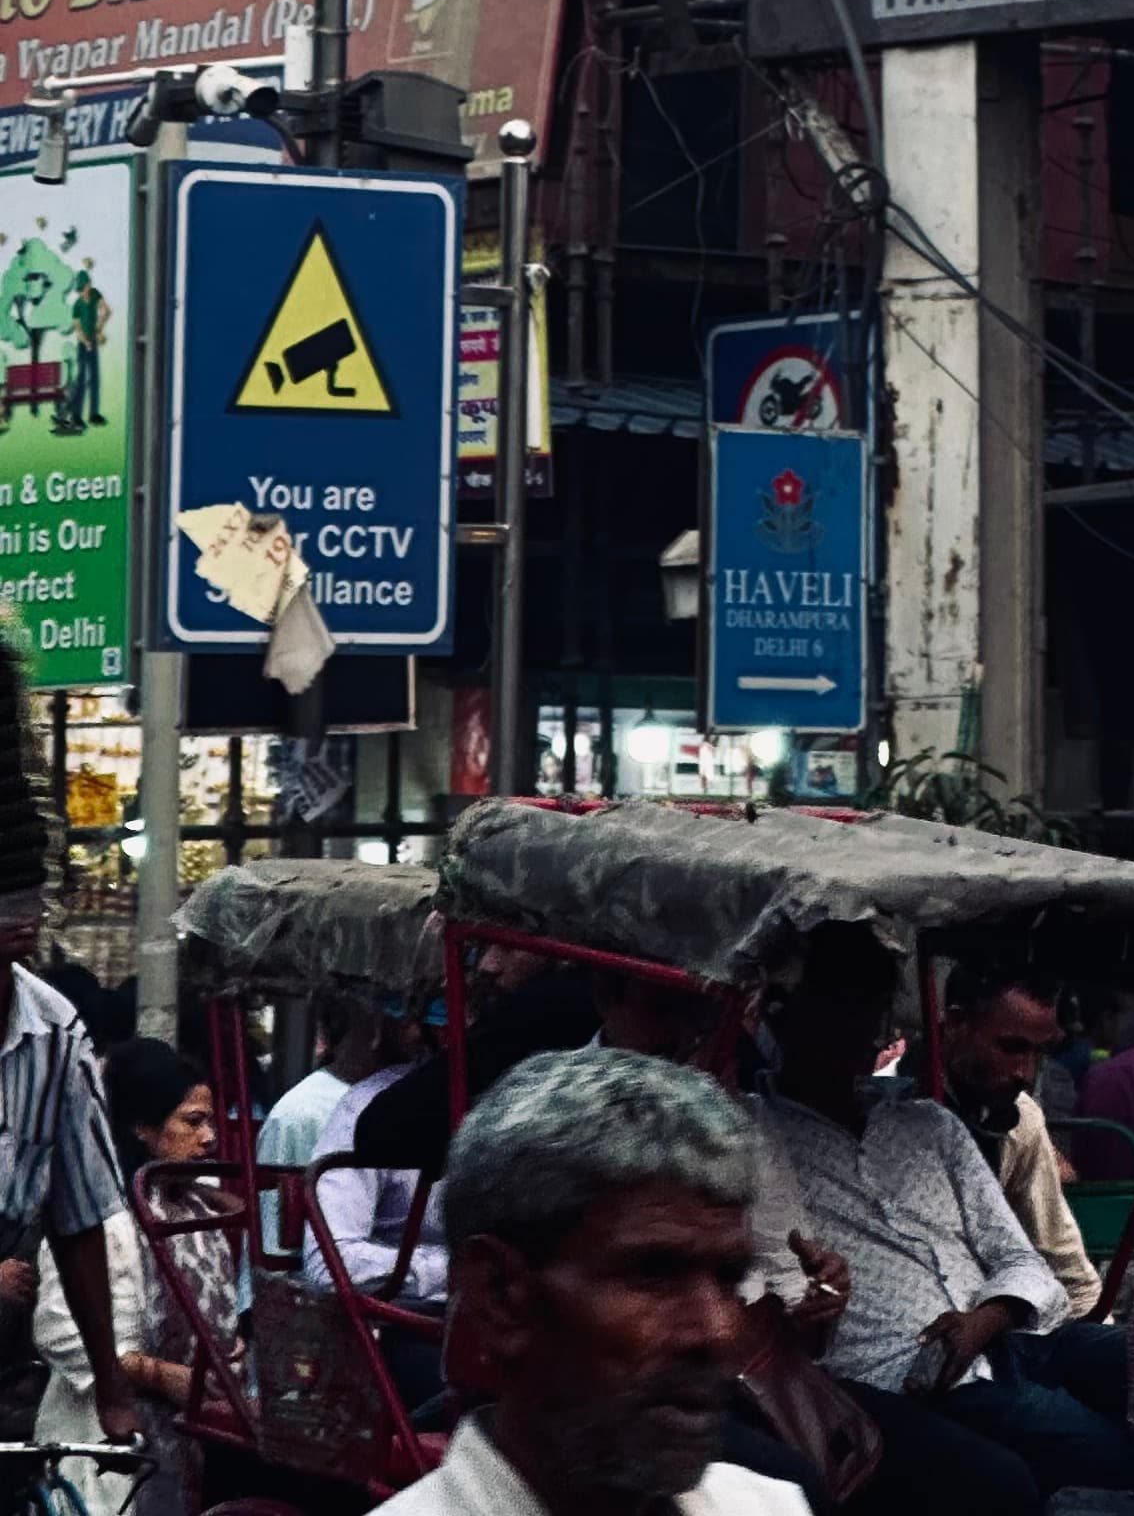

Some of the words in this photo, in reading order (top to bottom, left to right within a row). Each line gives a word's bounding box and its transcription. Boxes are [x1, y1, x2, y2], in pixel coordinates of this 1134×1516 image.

[131, 2, 257, 62] Mandal
[20, 473, 38, 505] &
[46, 470, 122, 503] Green
[248, 476, 312, 511] You
[323, 485, 376, 512] are
[28, 522, 50, 553] is
[58, 518, 106, 552] Our
[317, 524, 414, 559] CCTV
[723, 568, 853, 607] HAVELI
[40, 615, 106, 651] Delhi
[753, 636, 809, 658] DELHI
